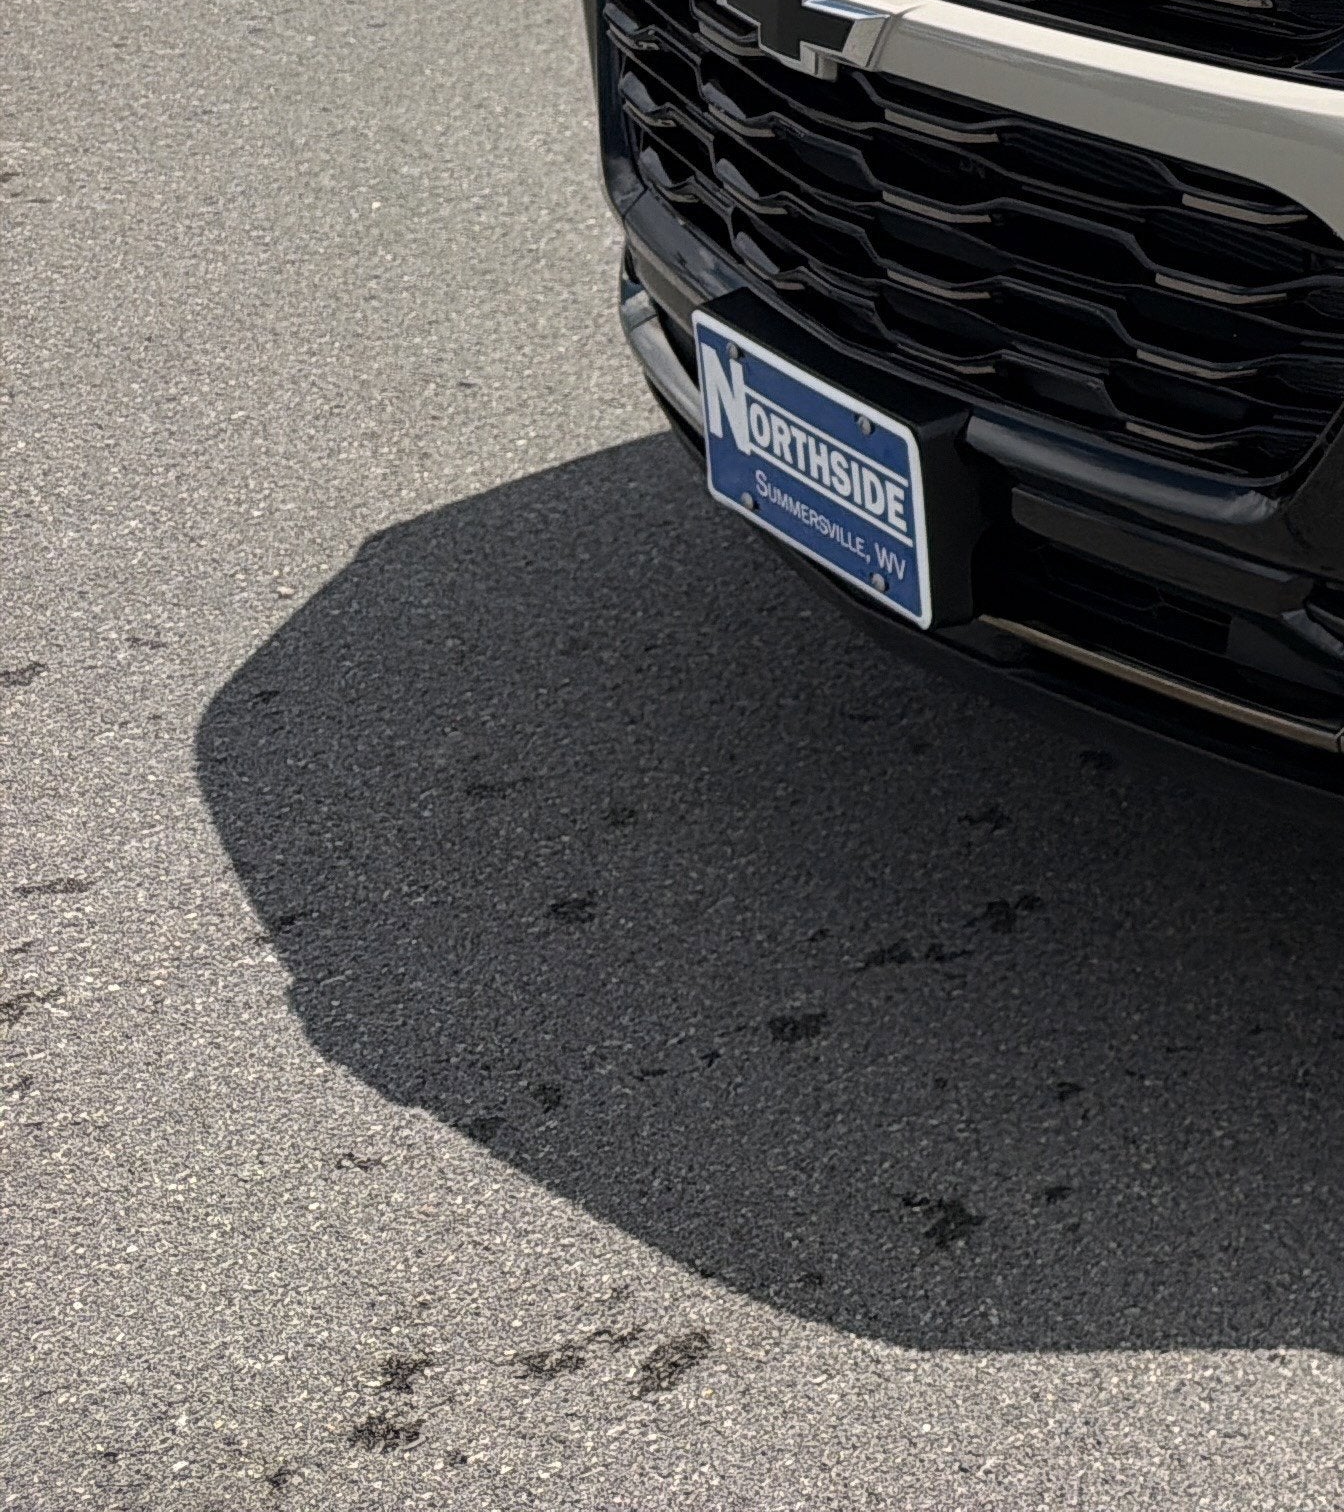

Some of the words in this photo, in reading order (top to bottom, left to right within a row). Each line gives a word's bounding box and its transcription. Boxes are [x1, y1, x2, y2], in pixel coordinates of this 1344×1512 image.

[700, 342, 908, 534] NORTHSIDE
[755, 469, 872, 565] SUMMERSVILLE,
[873, 541, 908, 581] WV
